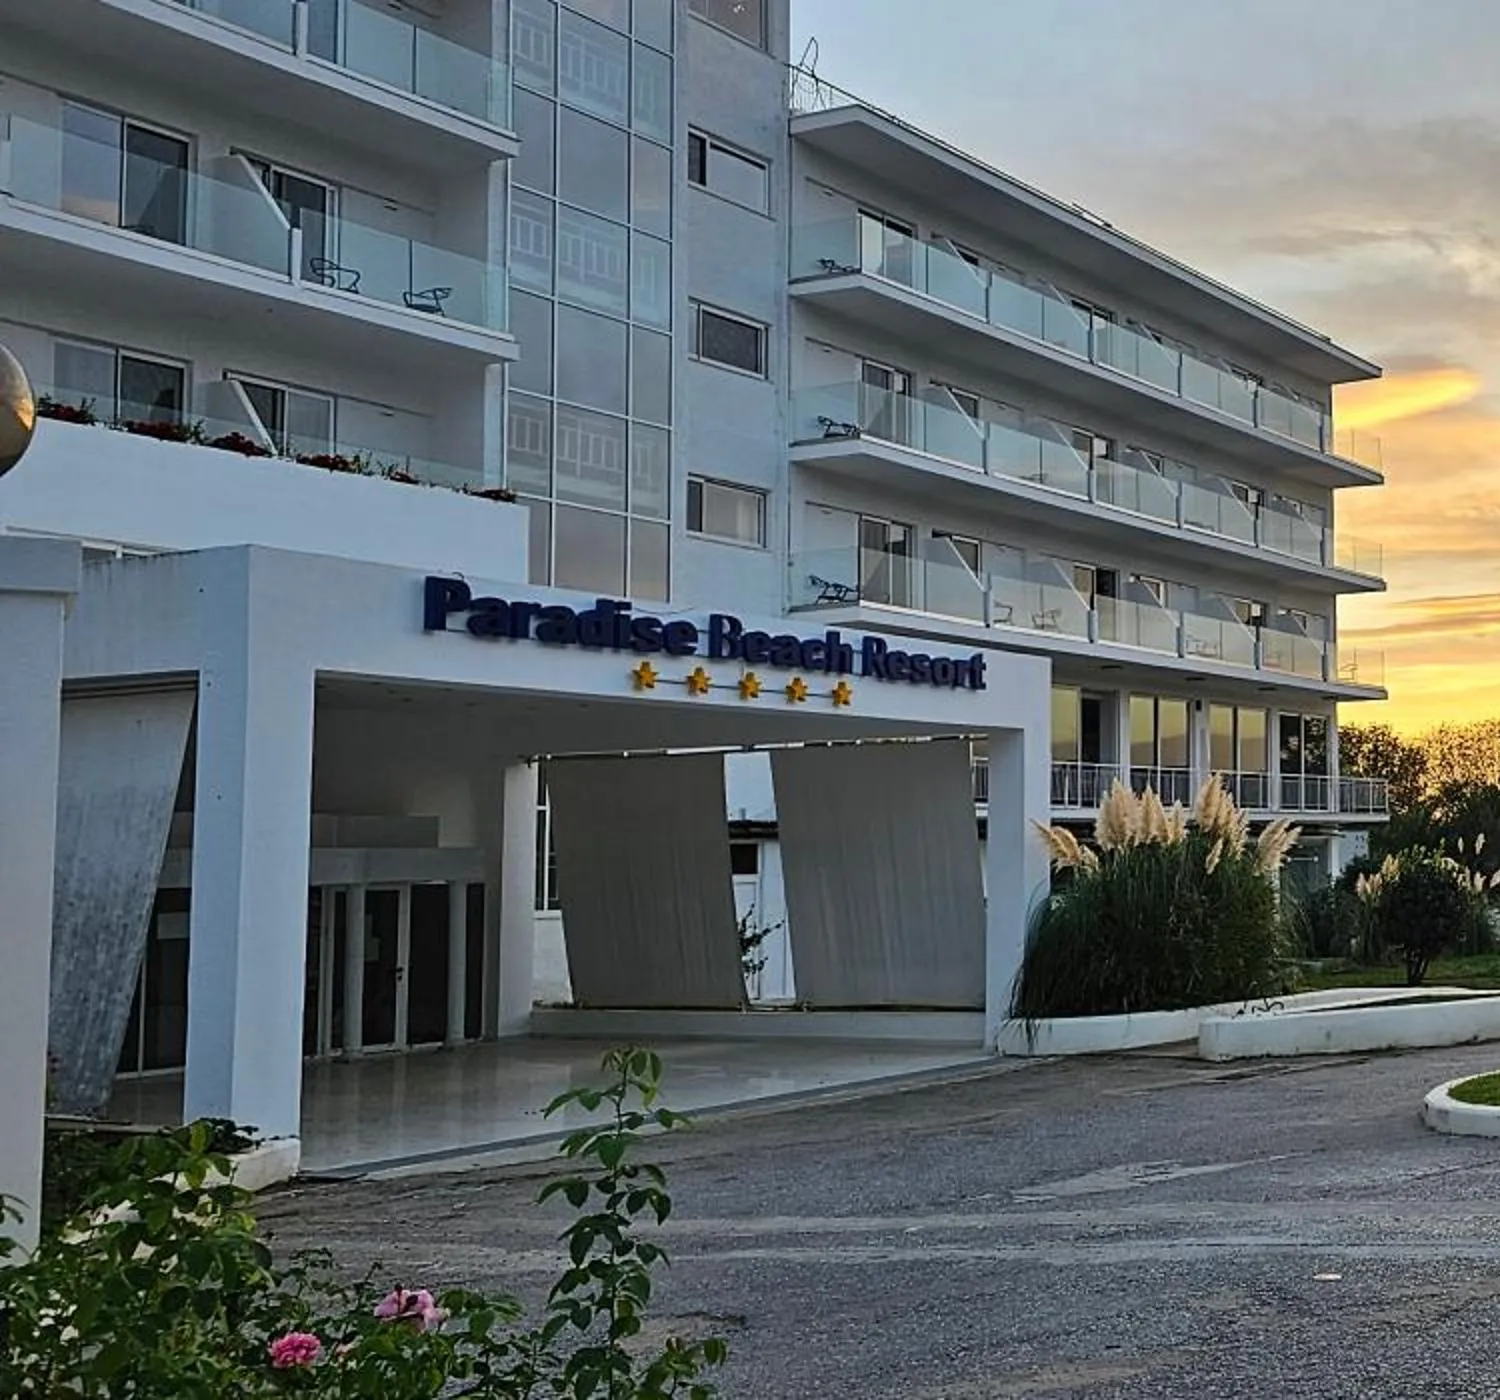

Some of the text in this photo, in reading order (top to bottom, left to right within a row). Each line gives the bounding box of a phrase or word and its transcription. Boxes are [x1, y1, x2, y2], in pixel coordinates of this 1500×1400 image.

[423, 575, 987, 691] Paradise Beach Resort
